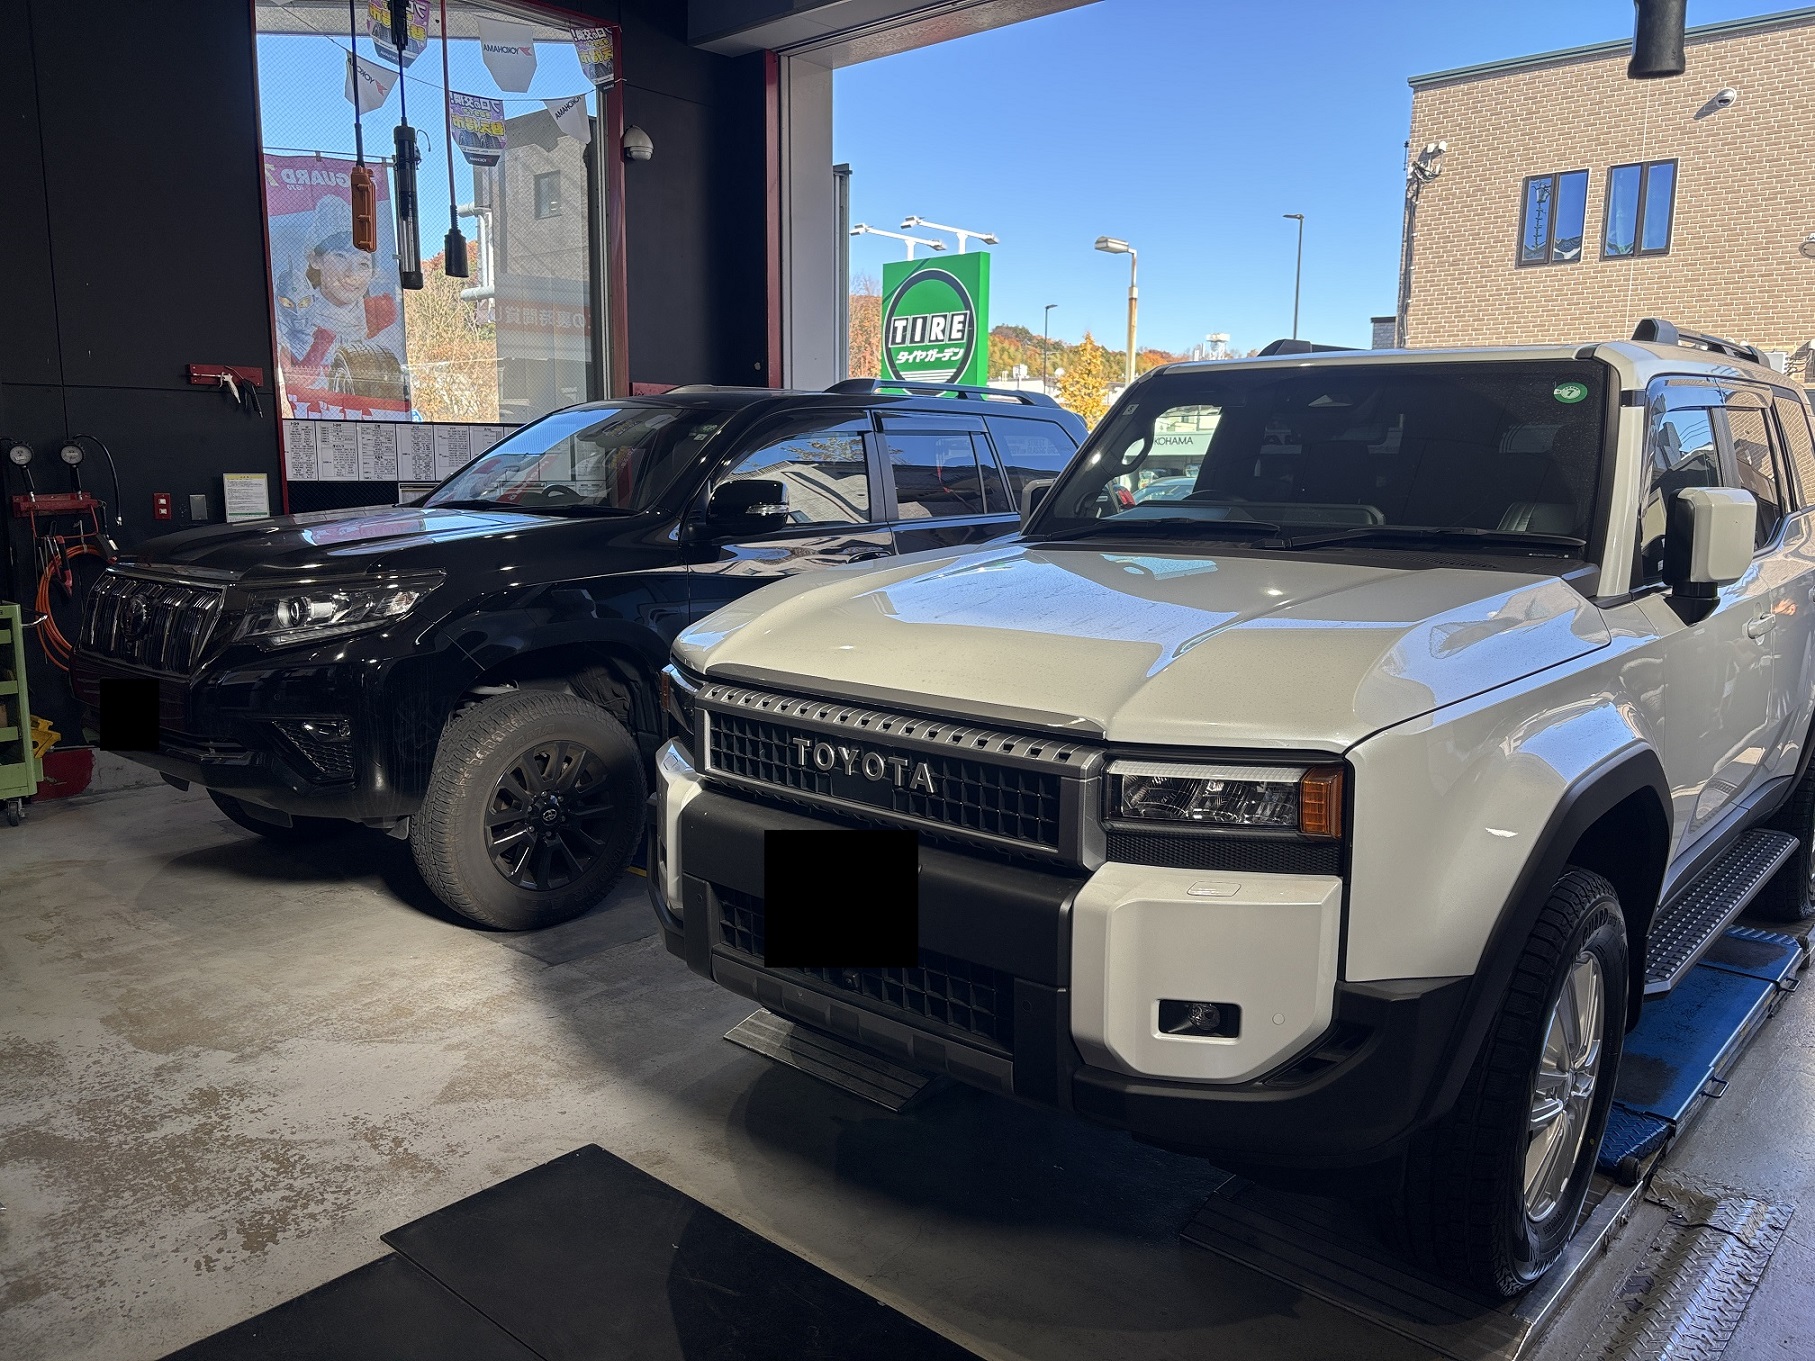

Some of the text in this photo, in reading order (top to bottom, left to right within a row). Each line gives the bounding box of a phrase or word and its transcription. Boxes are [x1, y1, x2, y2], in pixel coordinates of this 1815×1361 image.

[894, 314, 965, 344] TIRE
[896, 347, 965, 364] タイヤガーデン
[1154, 436, 1194, 446] KOHAMA
[792, 737, 935, 793] TOYOTA
